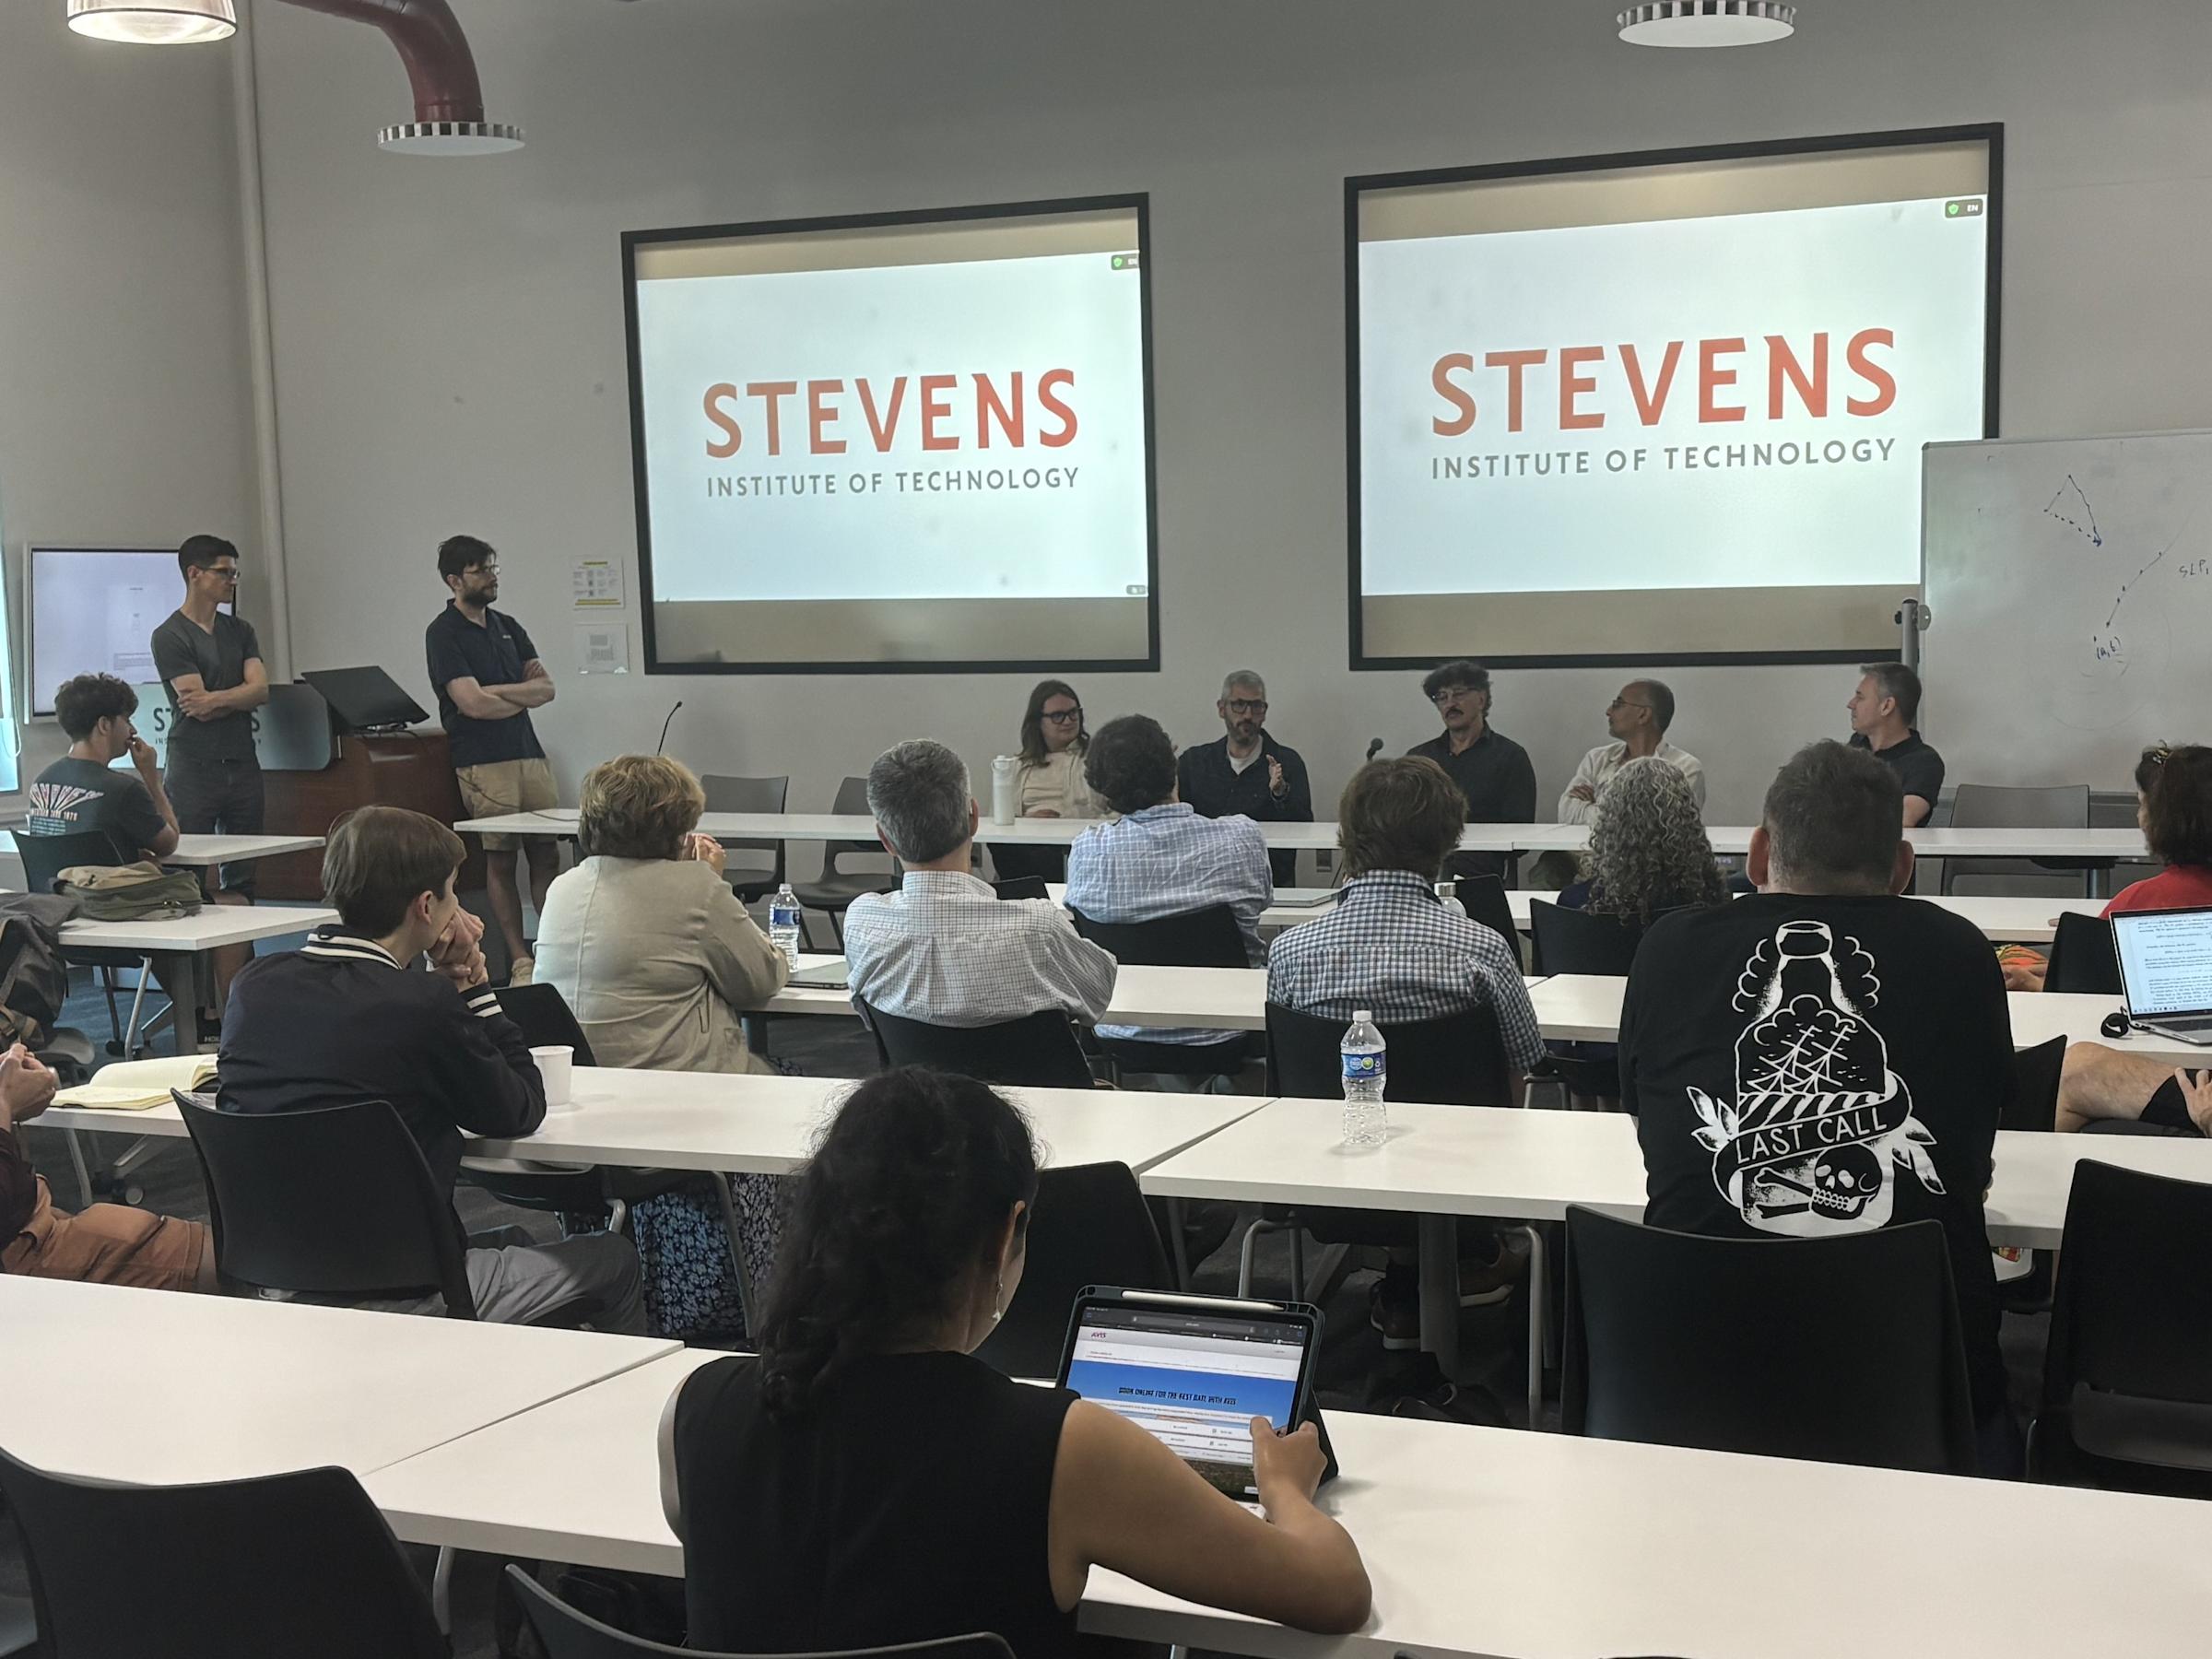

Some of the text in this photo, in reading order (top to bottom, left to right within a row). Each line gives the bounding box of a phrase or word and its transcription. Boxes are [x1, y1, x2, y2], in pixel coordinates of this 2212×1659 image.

[1432, 328, 1897, 436] STEVENS
[703, 369, 1078, 458] STEVENS
[707, 467, 1079, 498] INSTITUTE OF TECHNOLOGY
[1432, 438, 1896, 479] INSTITUTE OF TECHNOLOGY
[1736, 1107, 1888, 1165] LAST CALL
